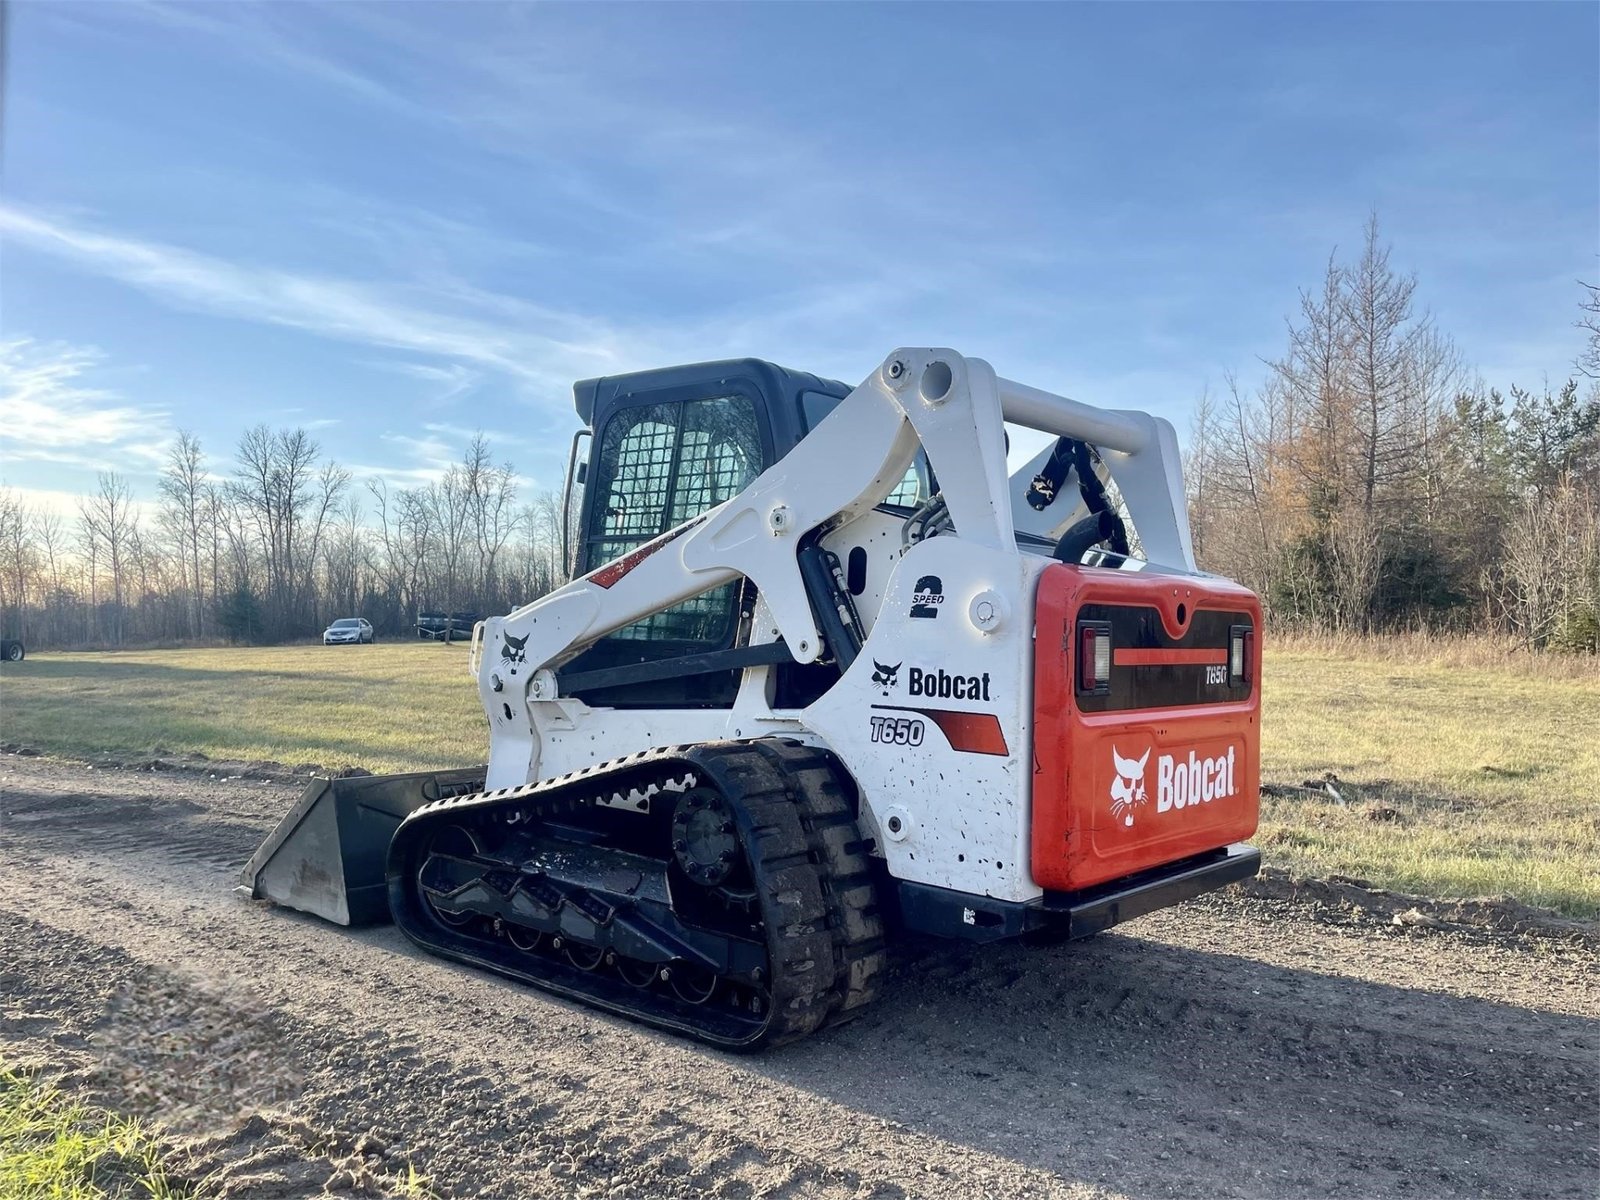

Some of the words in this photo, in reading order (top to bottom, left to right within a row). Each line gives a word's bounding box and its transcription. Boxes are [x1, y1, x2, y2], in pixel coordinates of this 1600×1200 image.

[909, 575, 943, 619] 2
[912, 594, 945, 604] SPEED
[909, 667, 991, 701] Bobcat
[1206, 665, 1227, 685] T650
[870, 716, 925, 747] T650
[1157, 745, 1235, 813] Bobcat
